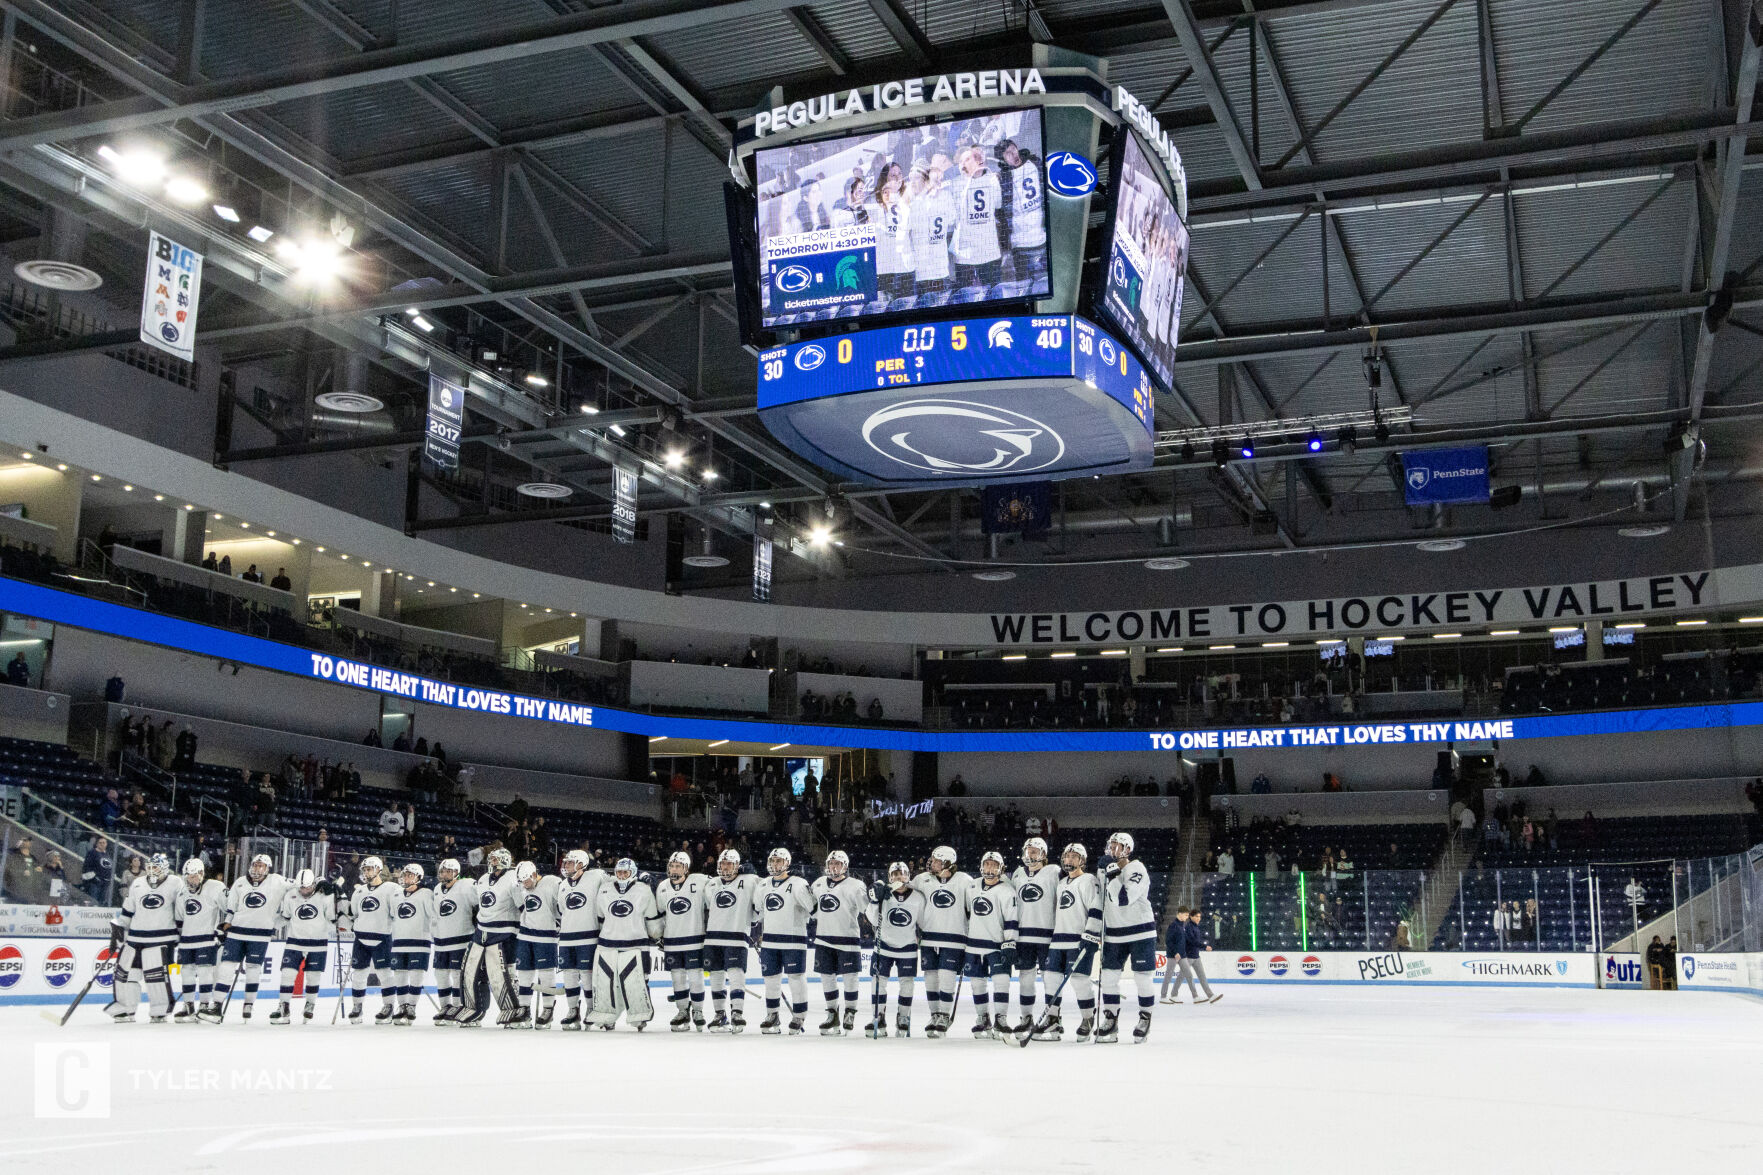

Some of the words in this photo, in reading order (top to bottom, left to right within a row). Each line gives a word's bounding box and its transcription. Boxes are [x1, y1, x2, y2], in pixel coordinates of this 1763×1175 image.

[755, 89, 865, 137] PEGULA
[873, 78, 925, 111] ICE
[932, 69, 1046, 101] ARENA
[1114, 85, 1169, 158] PEGULA
[974, 189, 985, 211] S
[769, 235, 800, 246] NEXT
[802, 230, 837, 242] HOME
[840, 225, 874, 237] GAME
[768, 242, 828, 257] TOMORROW
[835, 238, 858, 248] 4:30
[861, 236, 876, 245] PM
[784, 293, 865, 309] ticketmaster.com
[1031, 318, 1067, 327] SHOTS
[1076, 320, 1095, 336] SHOTS
[951, 325, 967, 350] 5
[1036, 329, 1062, 349] 40
[1079, 333, 1092, 356] 30
[760, 349, 787, 361] SHOTS
[837, 338, 852, 364] 0
[764, 360, 783, 381] 30
[875, 358, 905, 372] PER
[915, 356, 924, 367] 3
[1120, 351, 1127, 376] 0
[877, 377, 884, 386] 0
[888, 374, 910, 384] TOL
[916, 372, 922, 382] 1
[431, 402, 460, 420] TOURNAMENT
[430, 420, 459, 441] 2017
[613, 504, 635, 521] 2018
[991, 608, 1211, 643] WELCOME
[1229, 603, 1287, 634] TO
[1308, 590, 1503, 631] HOCKEY
[1523, 572, 1709, 618] VALLEY
[311, 654, 333, 678] TO
[336, 660, 368, 686] ONE
[371, 667, 419, 697] HEART
[421, 680, 456, 705] THAT
[458, 688, 510, 713] LOVES
[514, 697, 546, 718] THY
[548, 703, 592, 726] NAME
[1150, 733, 1175, 749] TO
[1180, 732, 1218, 749] ONE
[1223, 730, 1283, 747] HEART
[1289, 727, 1339, 746] THAT
[1344, 725, 1406, 744] LOVES
[1410, 723, 1450, 741] THY
[1455, 720, 1513, 740] NAME
[737, 879, 744, 889] A
[1129, 872, 1143, 884] 23
[690, 883, 697, 893] C
[785, 883, 793, 894] A
[24, 926, 61, 934] HIGHMARK
[0, 963, 22, 971] EPSI
[45, 962, 73, 971] PEPSI
[95, 963, 115, 971] PEP
[1358, 952, 1404, 980] PSECU
[1472, 962, 1552, 976] HIGHMARK
